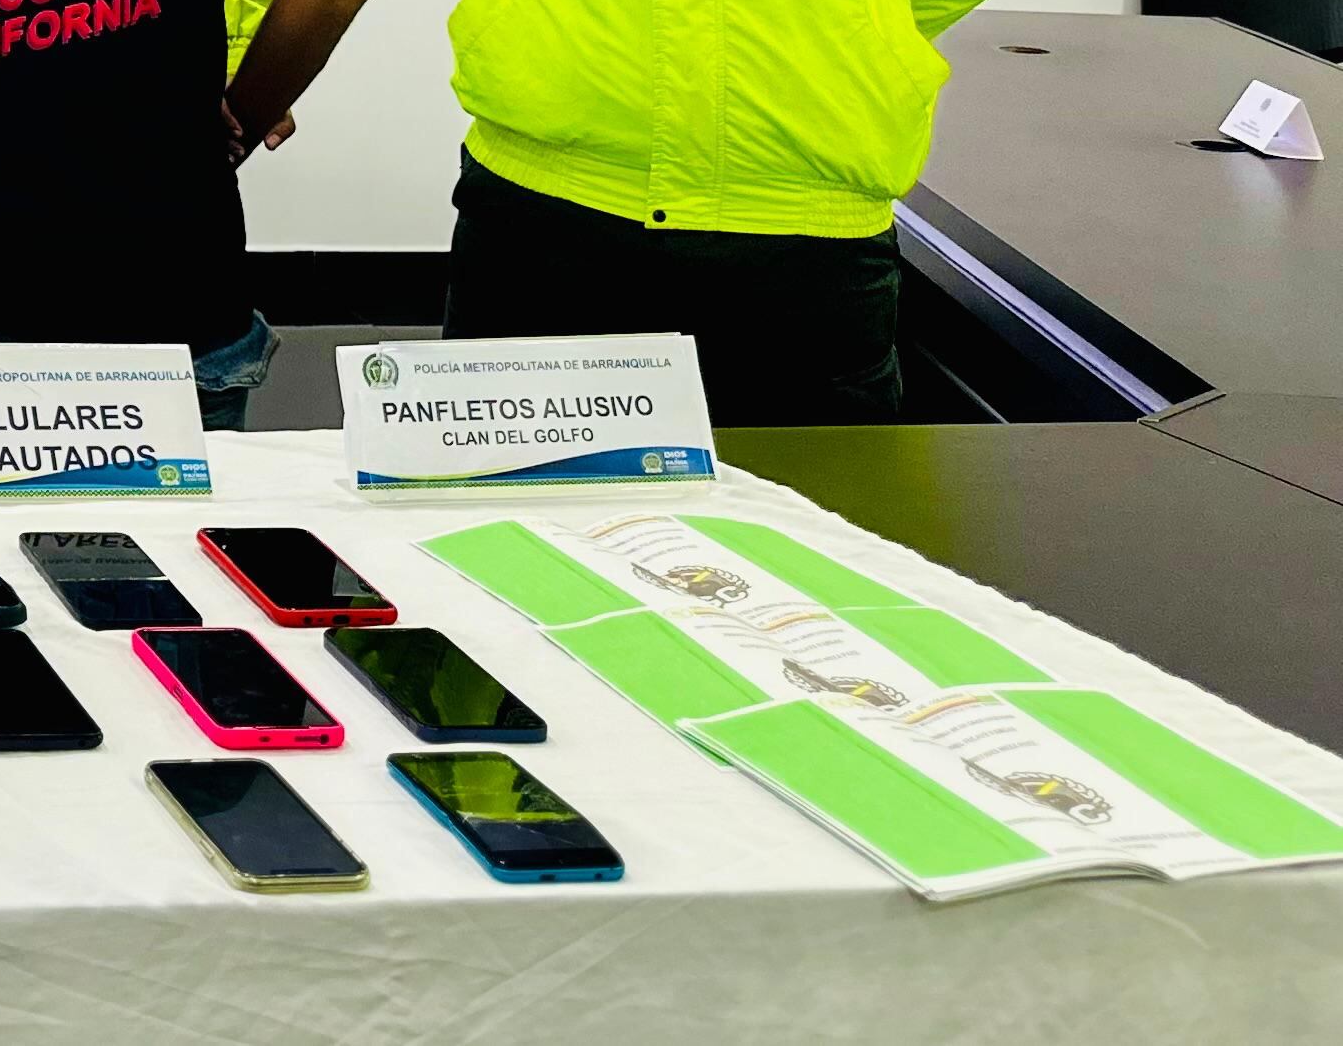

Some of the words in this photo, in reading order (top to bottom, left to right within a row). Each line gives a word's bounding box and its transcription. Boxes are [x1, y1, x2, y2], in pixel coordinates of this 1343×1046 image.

[463, 360, 561, 373] METROPOLITANA
[564, 359, 579, 370] DE
[582, 358, 672, 370] BARRANQUILLA
[76, 371, 92, 382] DE
[95, 370, 193, 382] BARRANQUILLA
[382, 399, 535, 423] PANFLETOS
[543, 395, 653, 419] ALUSIVO
[442, 431, 490, 447] CLAN
[495, 430, 529, 445] DEL
[534, 428, 594, 444] GOLFO
